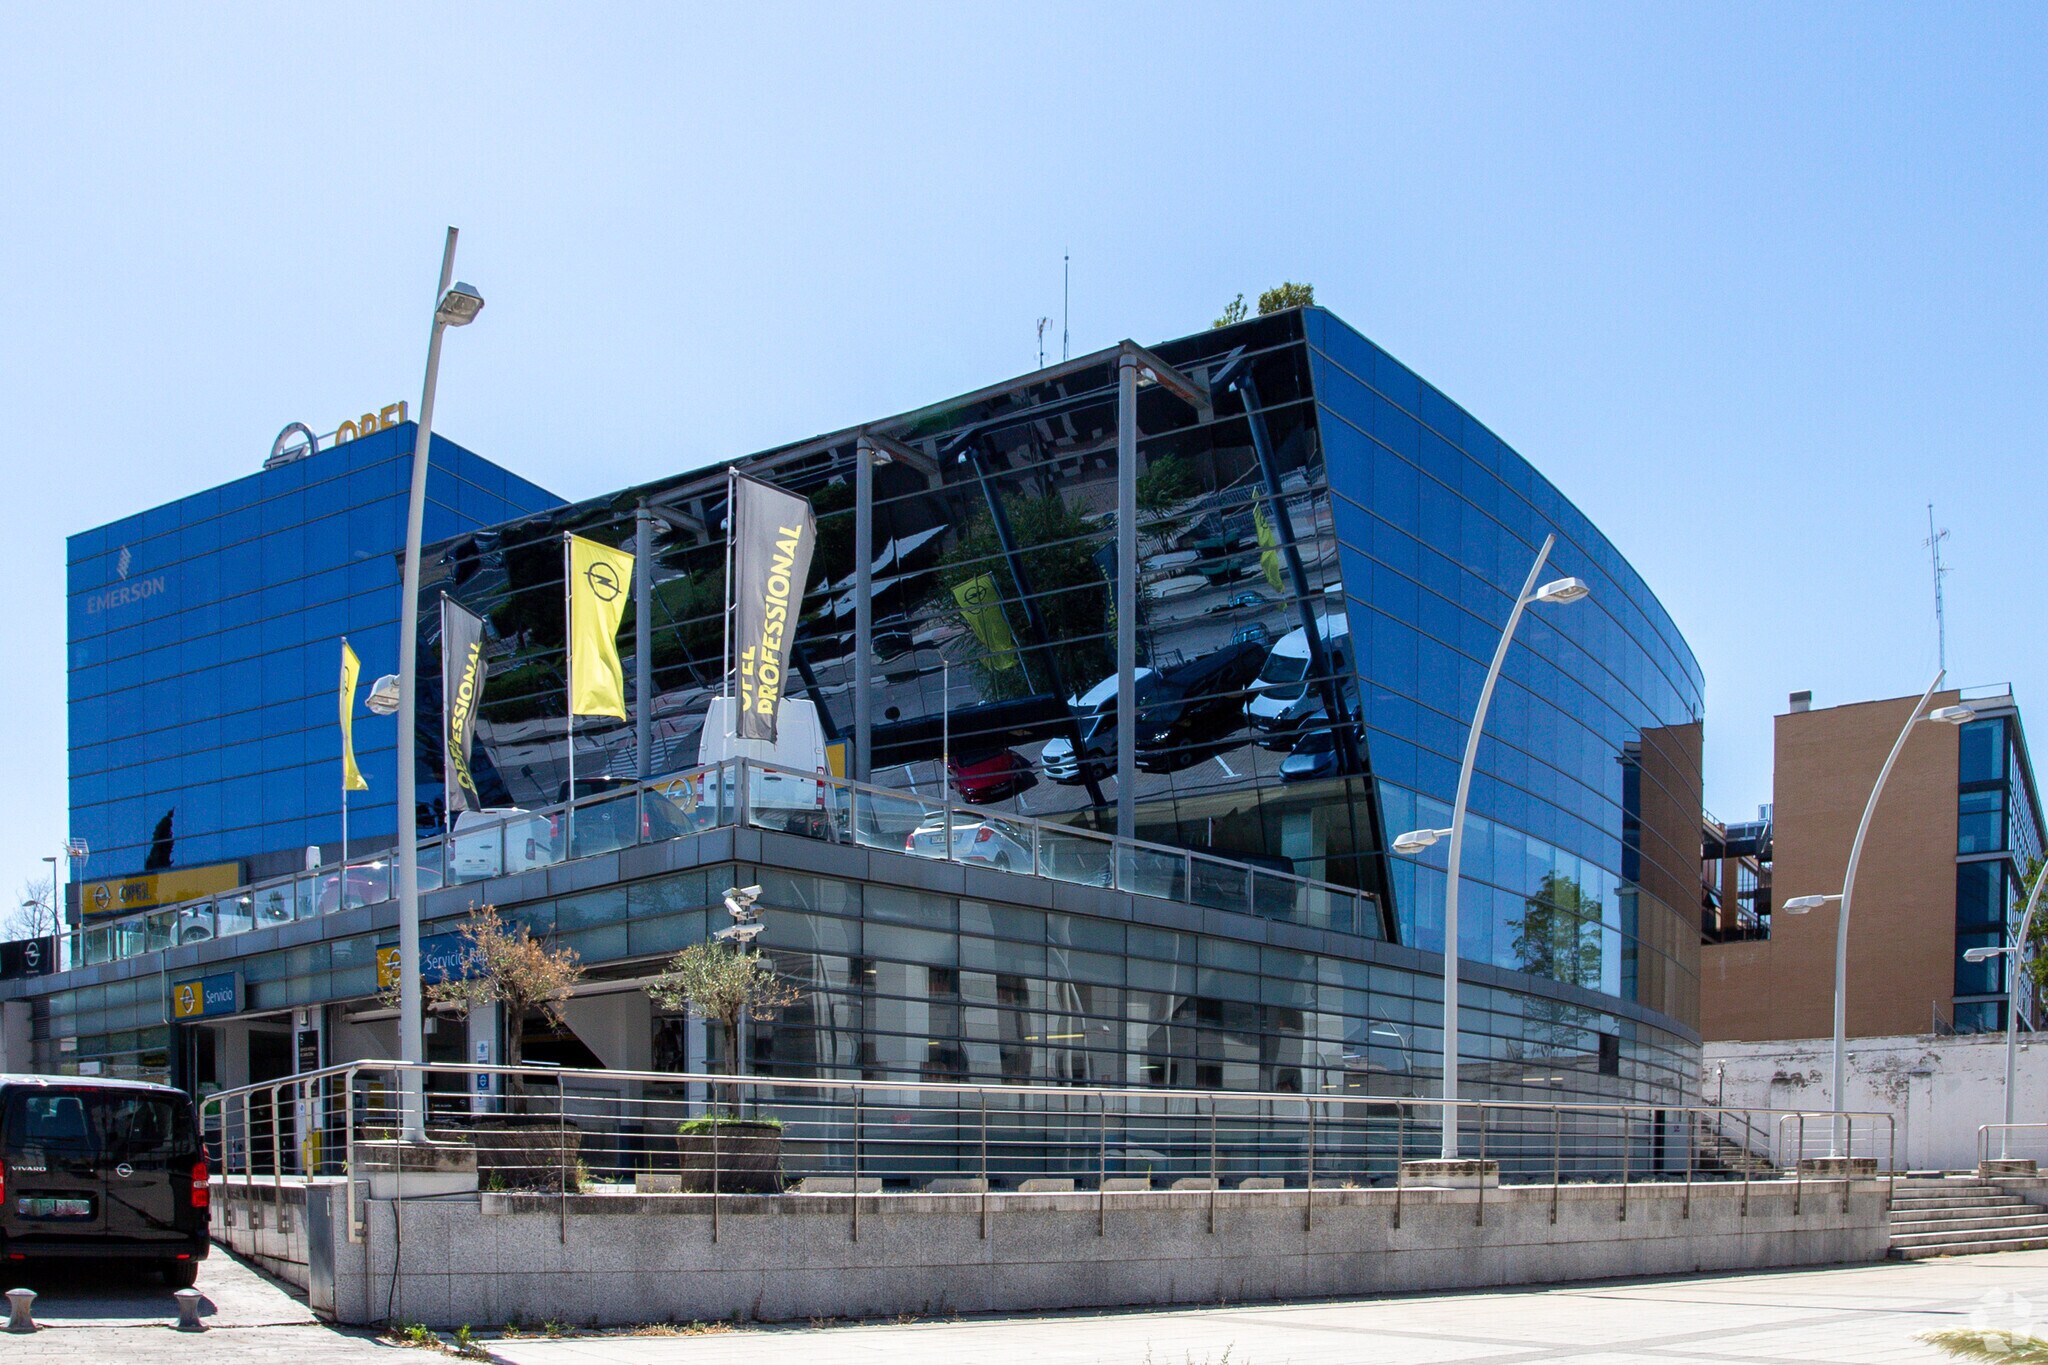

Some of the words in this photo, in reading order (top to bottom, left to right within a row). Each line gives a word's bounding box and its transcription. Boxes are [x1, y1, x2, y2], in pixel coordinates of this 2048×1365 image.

[87, 575, 165, 615] EMERSON
[757, 524, 802, 715] PROFESSIONAL
[205, 986, 233, 1004] Servicio
